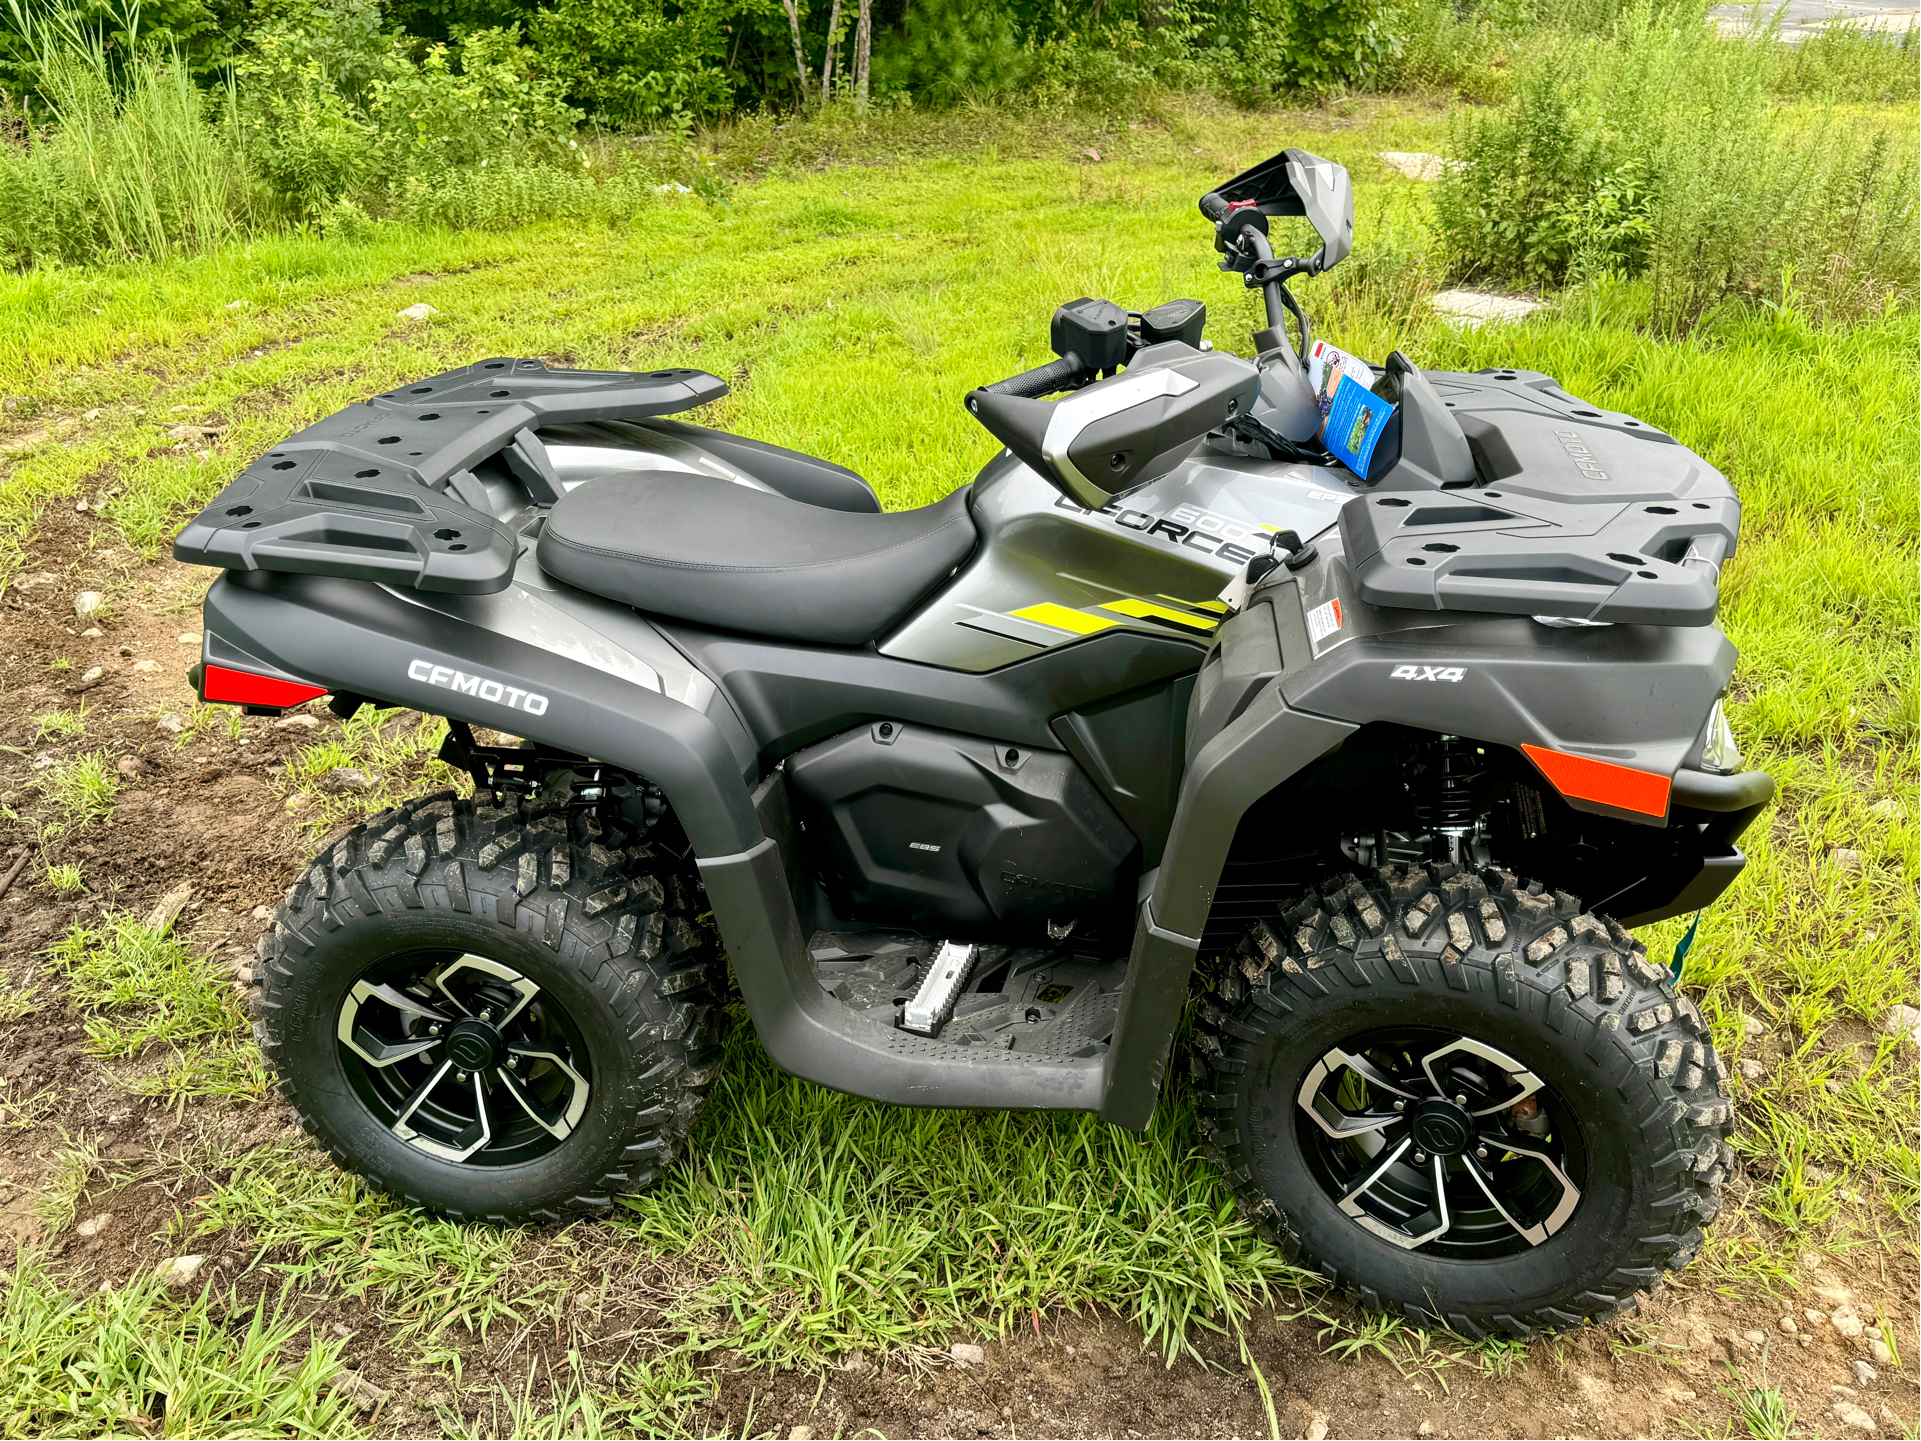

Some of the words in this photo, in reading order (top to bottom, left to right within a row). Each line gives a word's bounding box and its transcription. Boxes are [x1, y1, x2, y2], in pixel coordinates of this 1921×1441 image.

[1553, 430, 1609, 480] CFMOTO
[1307, 490, 1353, 504] EPS
[1169, 506, 1249, 541] 600
[407, 659, 549, 716] CFMOTO
[908, 842, 942, 852] EBS
[999, 870, 1100, 901] CFMOTO
[289, 961, 324, 1043] CFMOTO
[1247, 1107, 1284, 1196] CFMOTO
